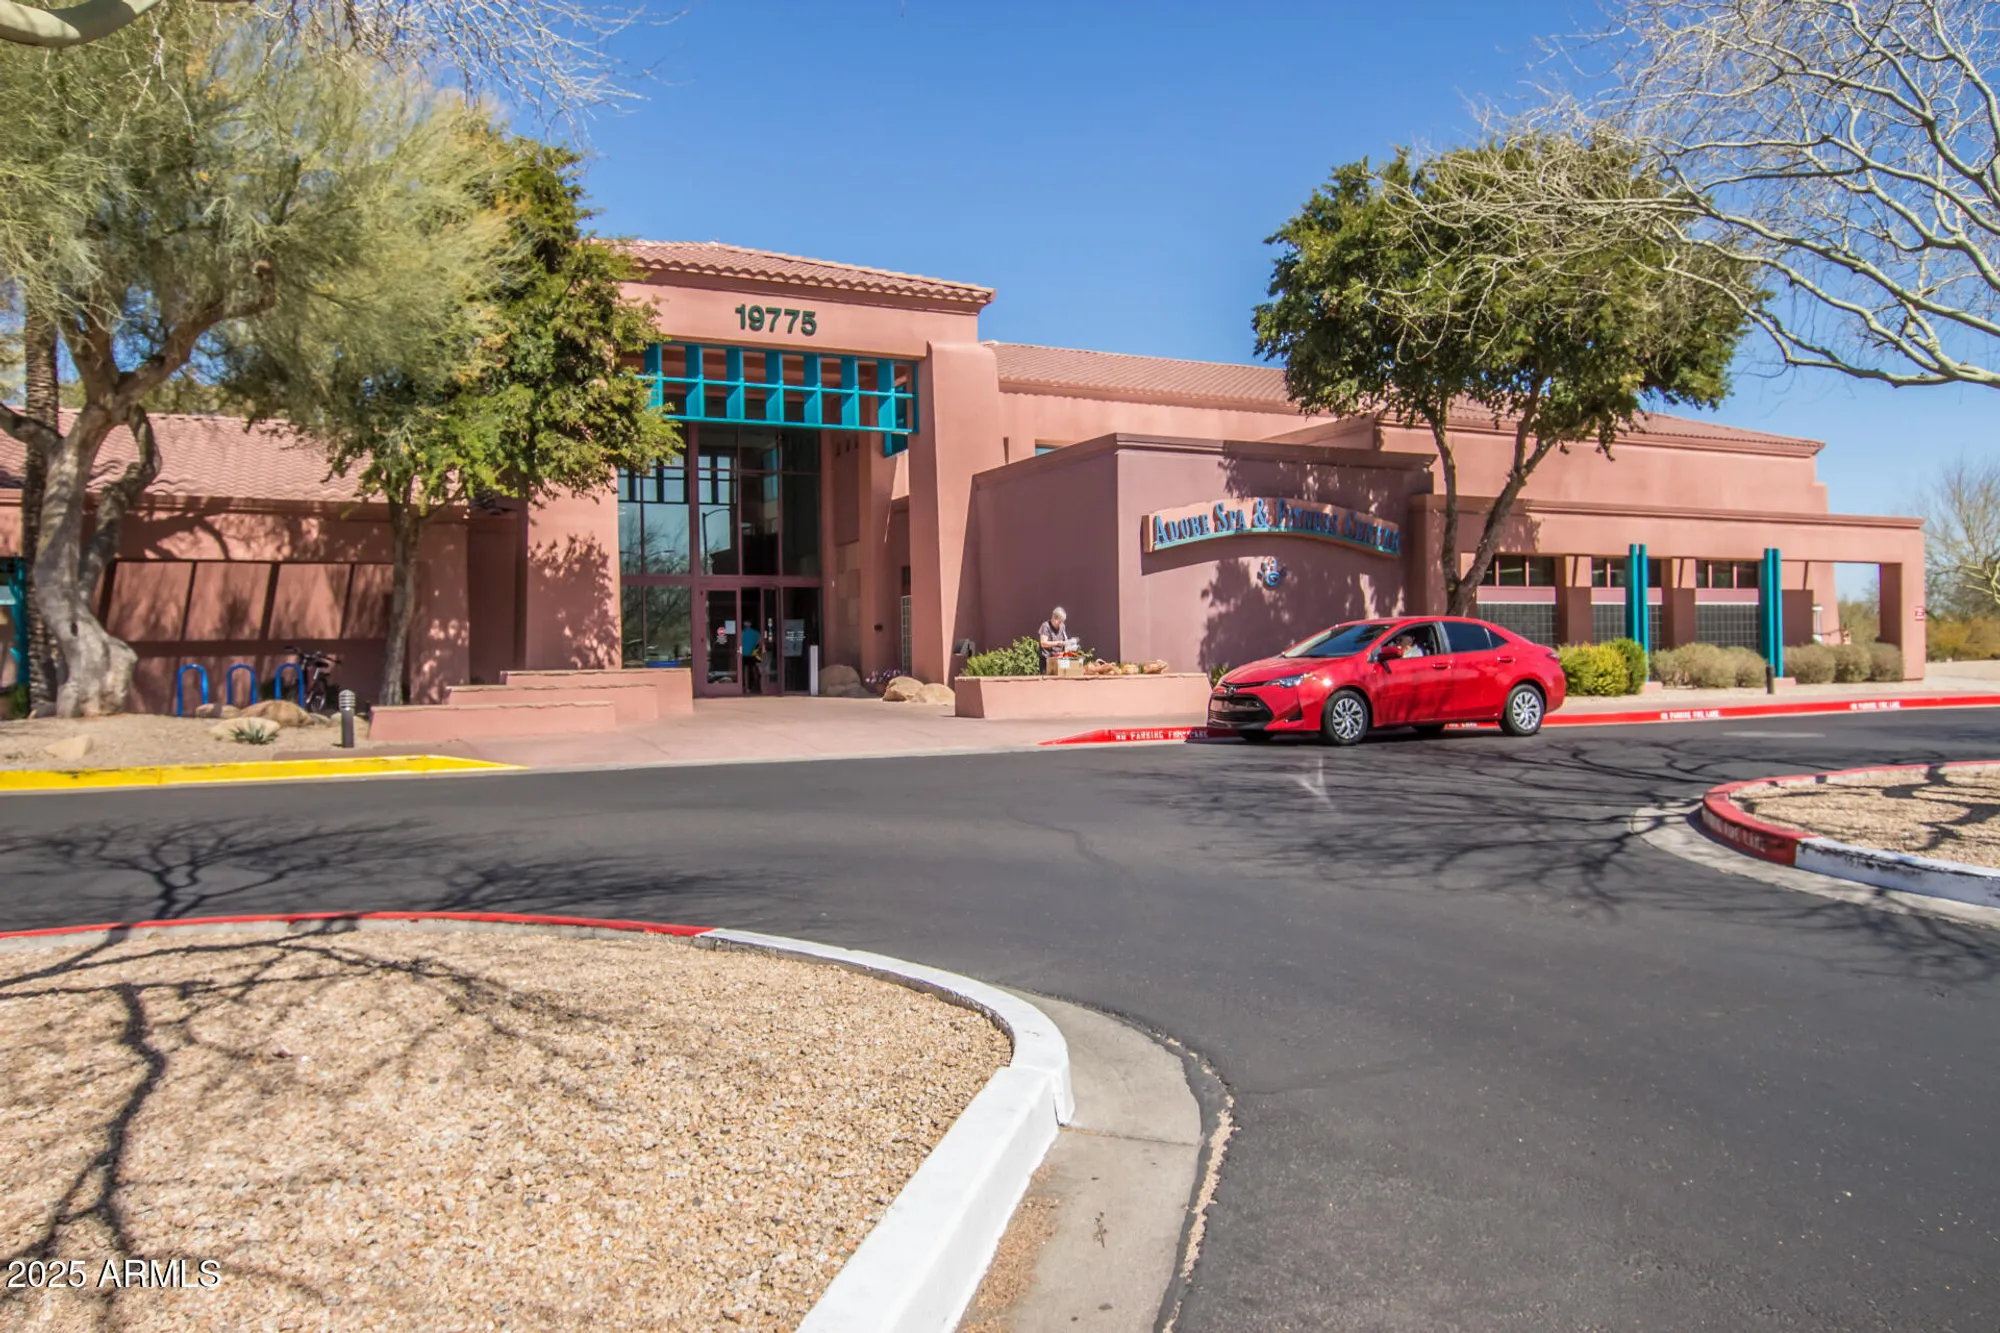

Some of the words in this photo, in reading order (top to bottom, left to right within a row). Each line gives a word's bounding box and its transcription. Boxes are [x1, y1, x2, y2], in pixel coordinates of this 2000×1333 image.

[735, 304, 818, 337] 19775
[1154, 514, 1211, 546] ADOBE
[1214, 502, 1247, 533] SPA
[1252, 498, 1271, 528] &
[1130, 730, 1165, 740] PARKING
